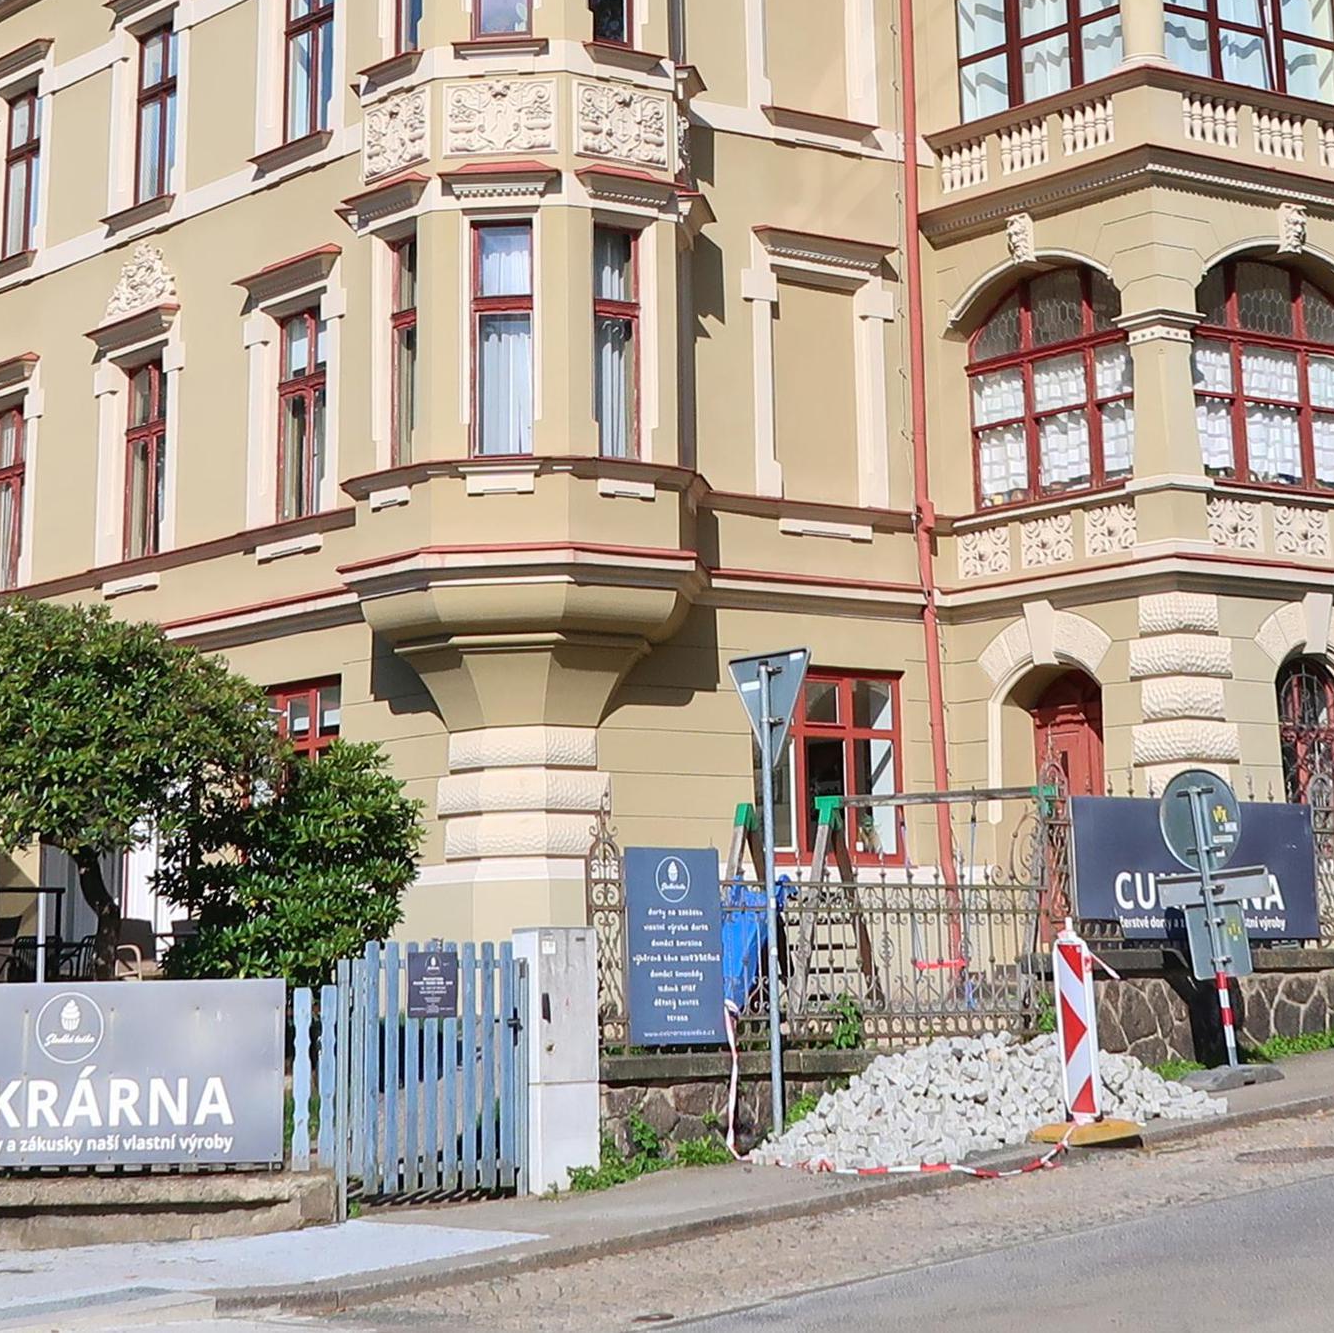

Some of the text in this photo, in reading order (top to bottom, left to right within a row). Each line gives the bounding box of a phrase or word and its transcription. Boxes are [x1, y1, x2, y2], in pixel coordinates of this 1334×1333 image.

[6, 1139, 16, 1153] a
[19, 1135, 83, 1156] zákusky
[87, 1134, 120, 1151] naší
[123, 1134, 177, 1151] vlastní
[179, 1133, 233, 1154] výroby
